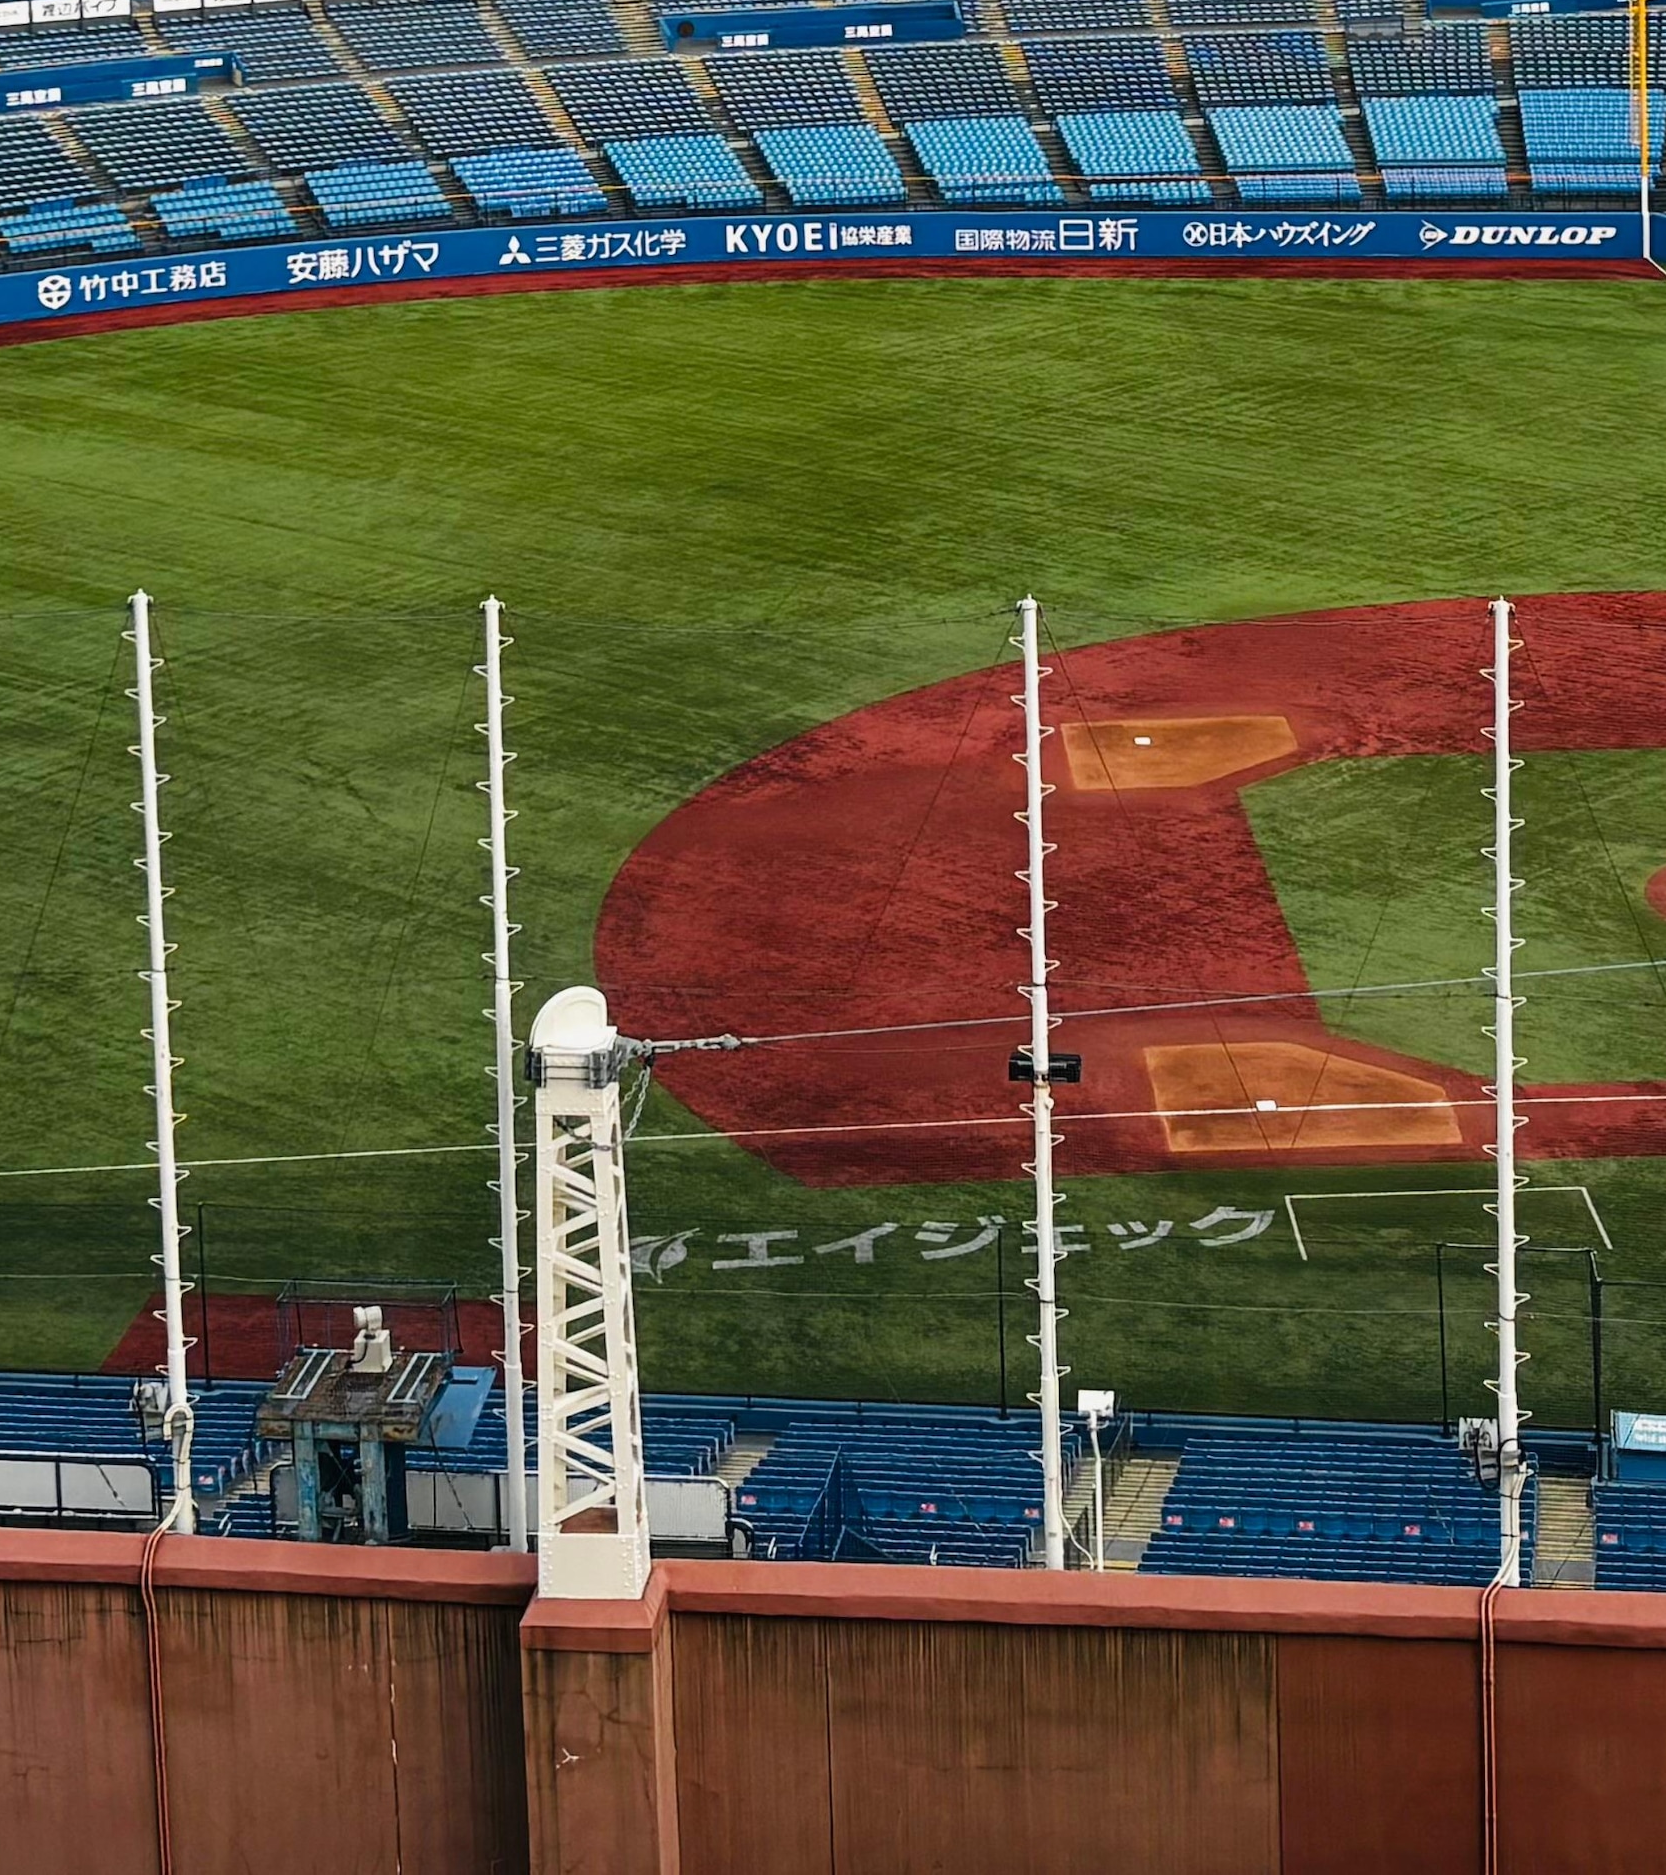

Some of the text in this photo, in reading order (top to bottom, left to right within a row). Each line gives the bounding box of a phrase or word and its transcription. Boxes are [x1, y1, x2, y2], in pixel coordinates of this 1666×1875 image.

[536, 229, 686, 263] 三菱ガス化学
[841, 224, 912, 246] 協栄産業
[1209, 221, 1376, 248] 日本ハウズイング
[1449, 226, 1617, 245] DUNLOP
[287, 240, 439, 283] 安藤ハザマ
[79, 261, 226, 301] 竹中工務店
[713, 1206, 1275, 1271] エイジェック
